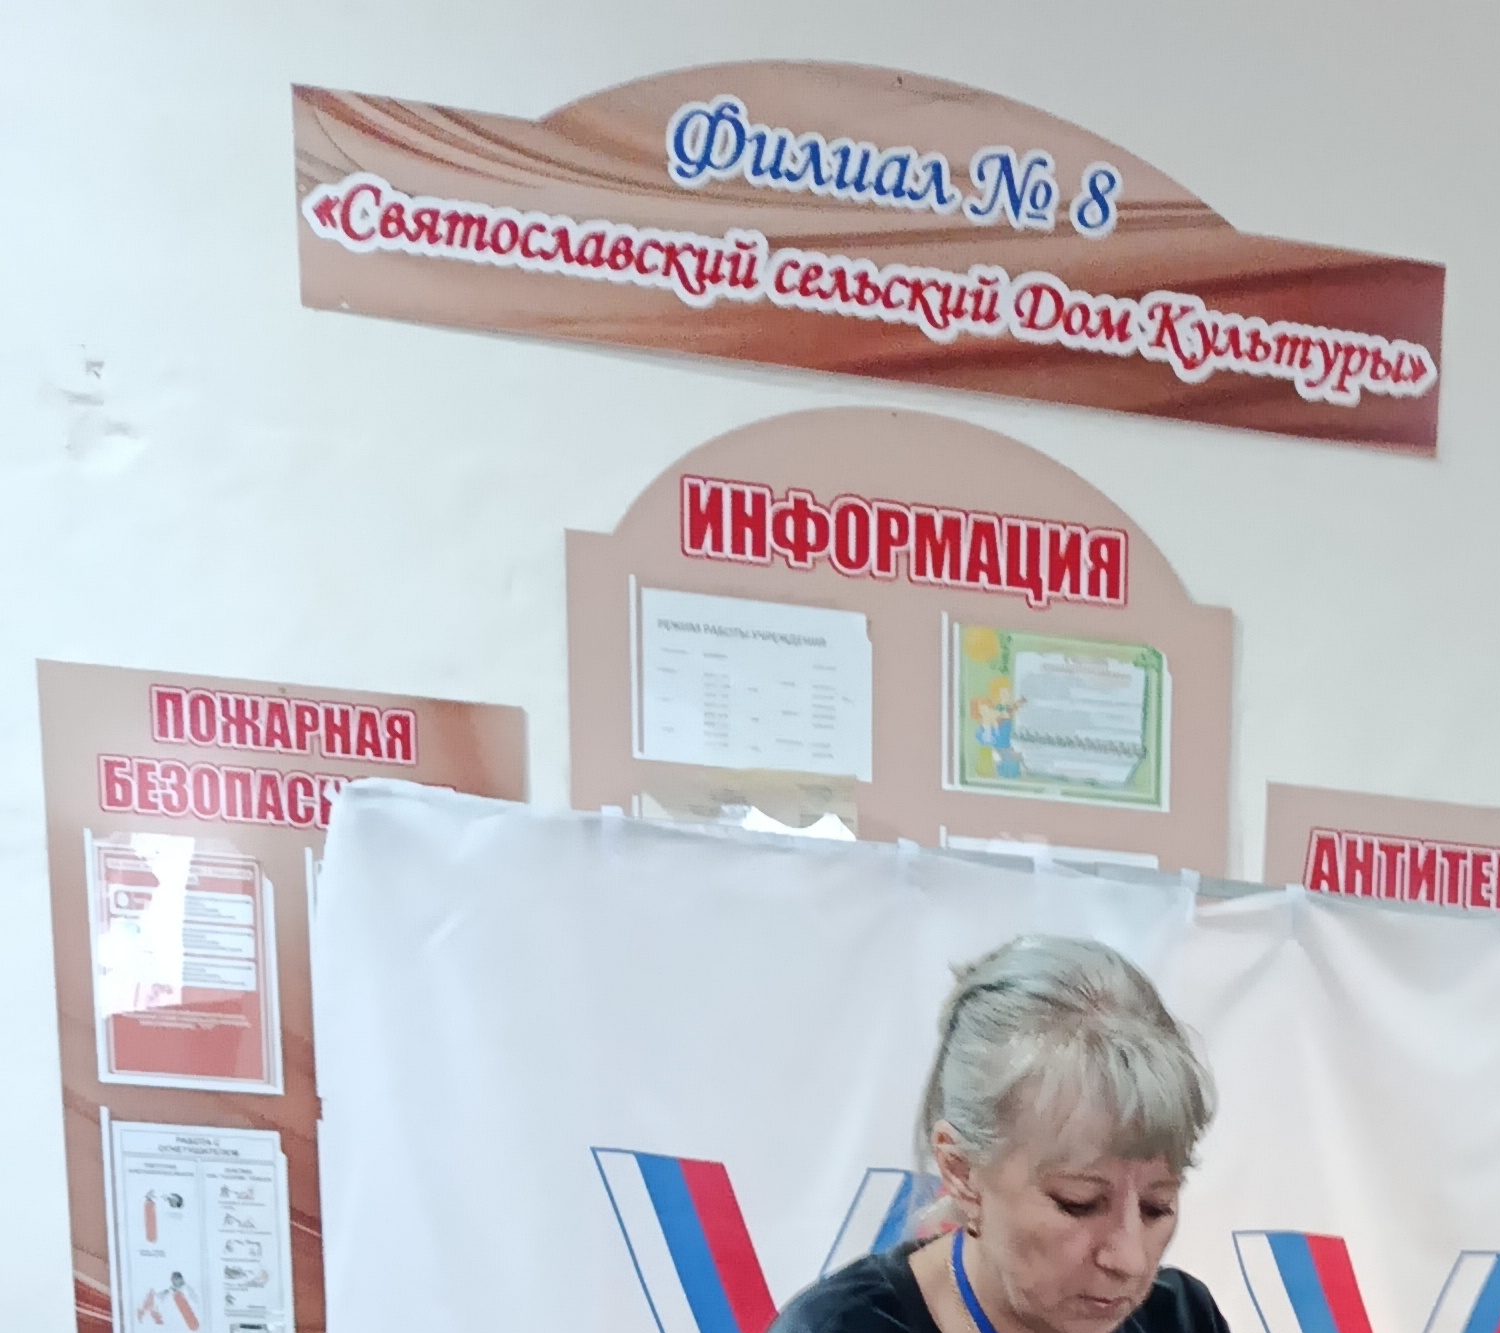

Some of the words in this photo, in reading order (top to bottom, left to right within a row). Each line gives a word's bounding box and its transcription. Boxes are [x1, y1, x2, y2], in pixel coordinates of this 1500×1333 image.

[674, 102, 955, 207] Филиал
[970, 153, 1053, 221] №
[1077, 168, 1117, 230] 8
[311, 183, 759, 296] «Святославский
[774, 258, 1001, 330] сельский
[1014, 283, 1133, 344] Дом
[1147, 300, 1429, 393] Культуры»
[682, 476, 1126, 608] ИНФОРМАЦИЯ
[152, 686, 415, 762] ПОЖАРНАЯ
[101, 757, 344, 829] БЕЗОПАСН
